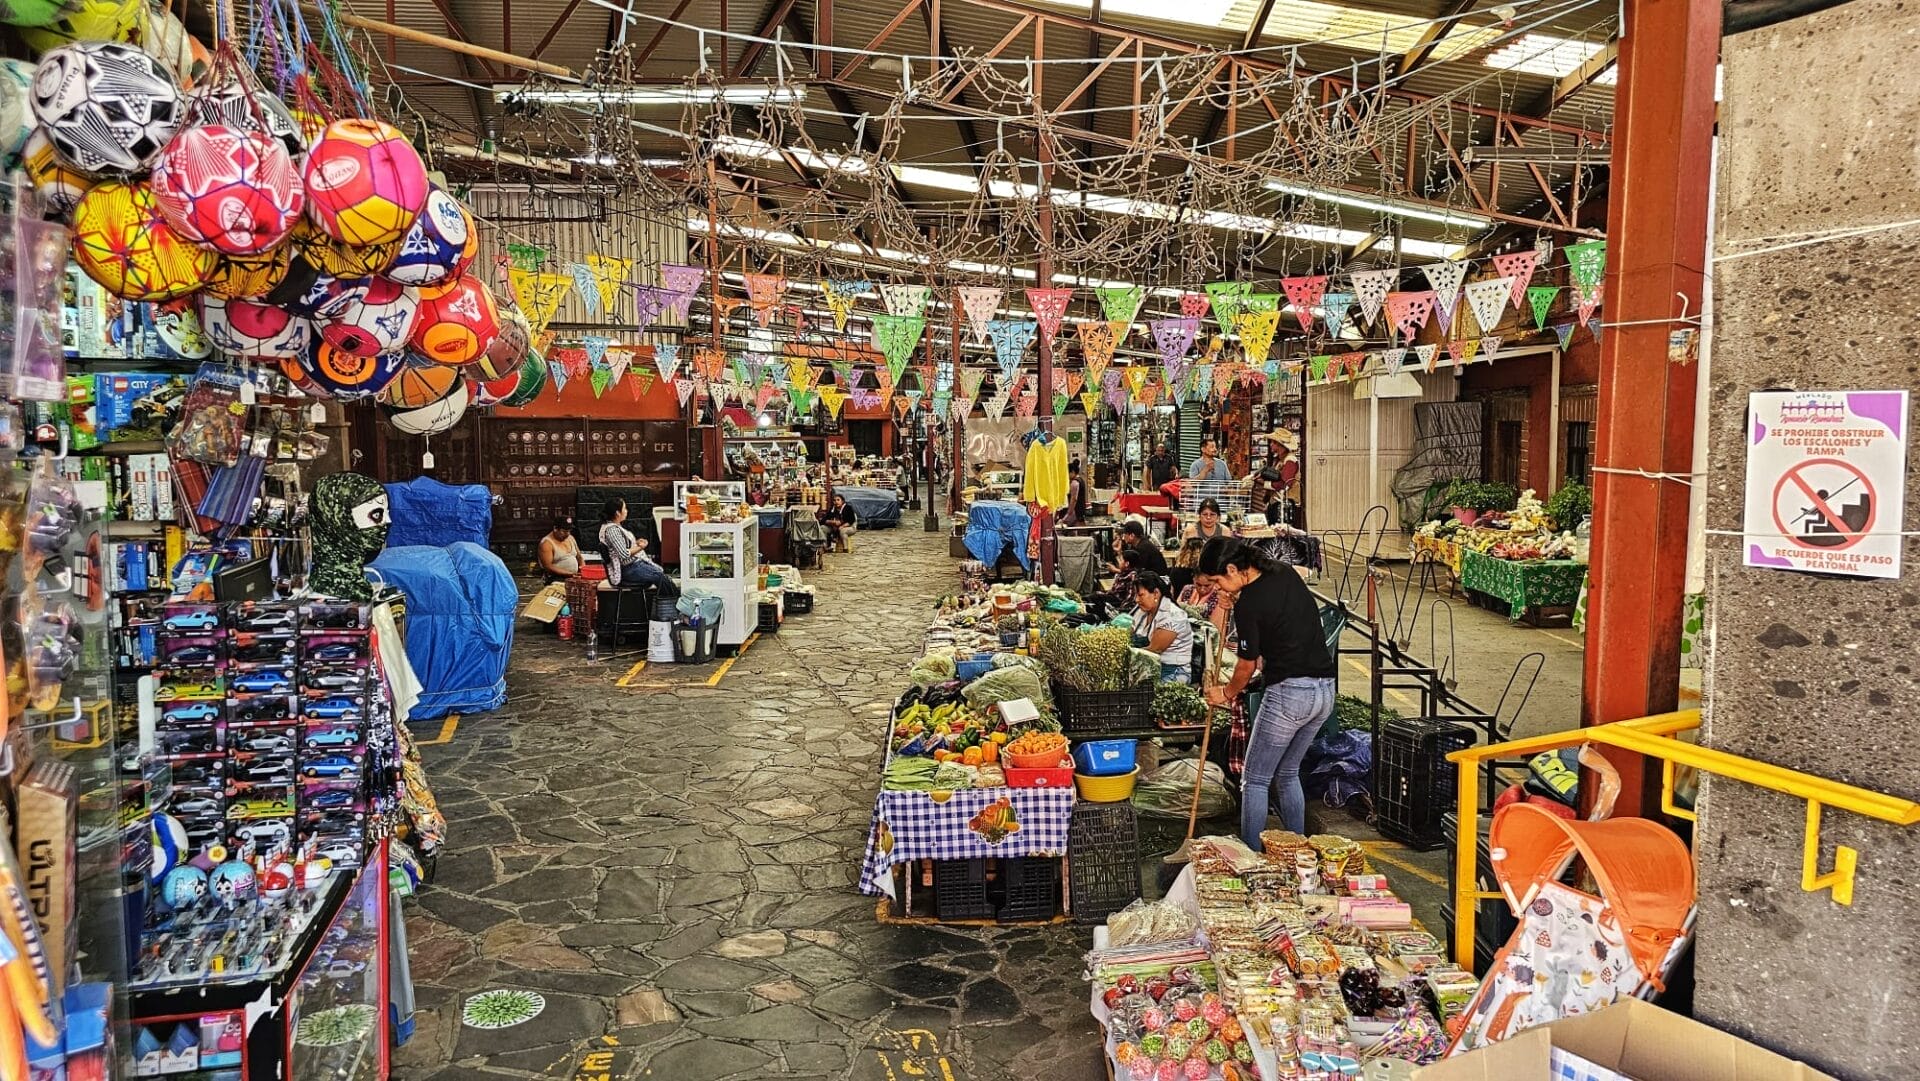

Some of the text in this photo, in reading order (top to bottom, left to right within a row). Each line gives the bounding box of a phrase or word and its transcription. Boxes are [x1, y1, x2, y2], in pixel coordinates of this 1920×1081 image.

[55, 66, 80, 110] PUMAS
[130, 380, 149, 389] CITY
[1771, 429, 1884, 438] SE PROHIBE OBSTRUIR
[654, 442, 674, 452] CFE
[1783, 438, 1871, 447] LOS ESCALONES Y
[1806, 447, 1845, 456] RAMPA
[1775, 548, 1893, 566] RECUERDE QUE ES PASO
[1805, 560, 1859, 572] PEATONAL
